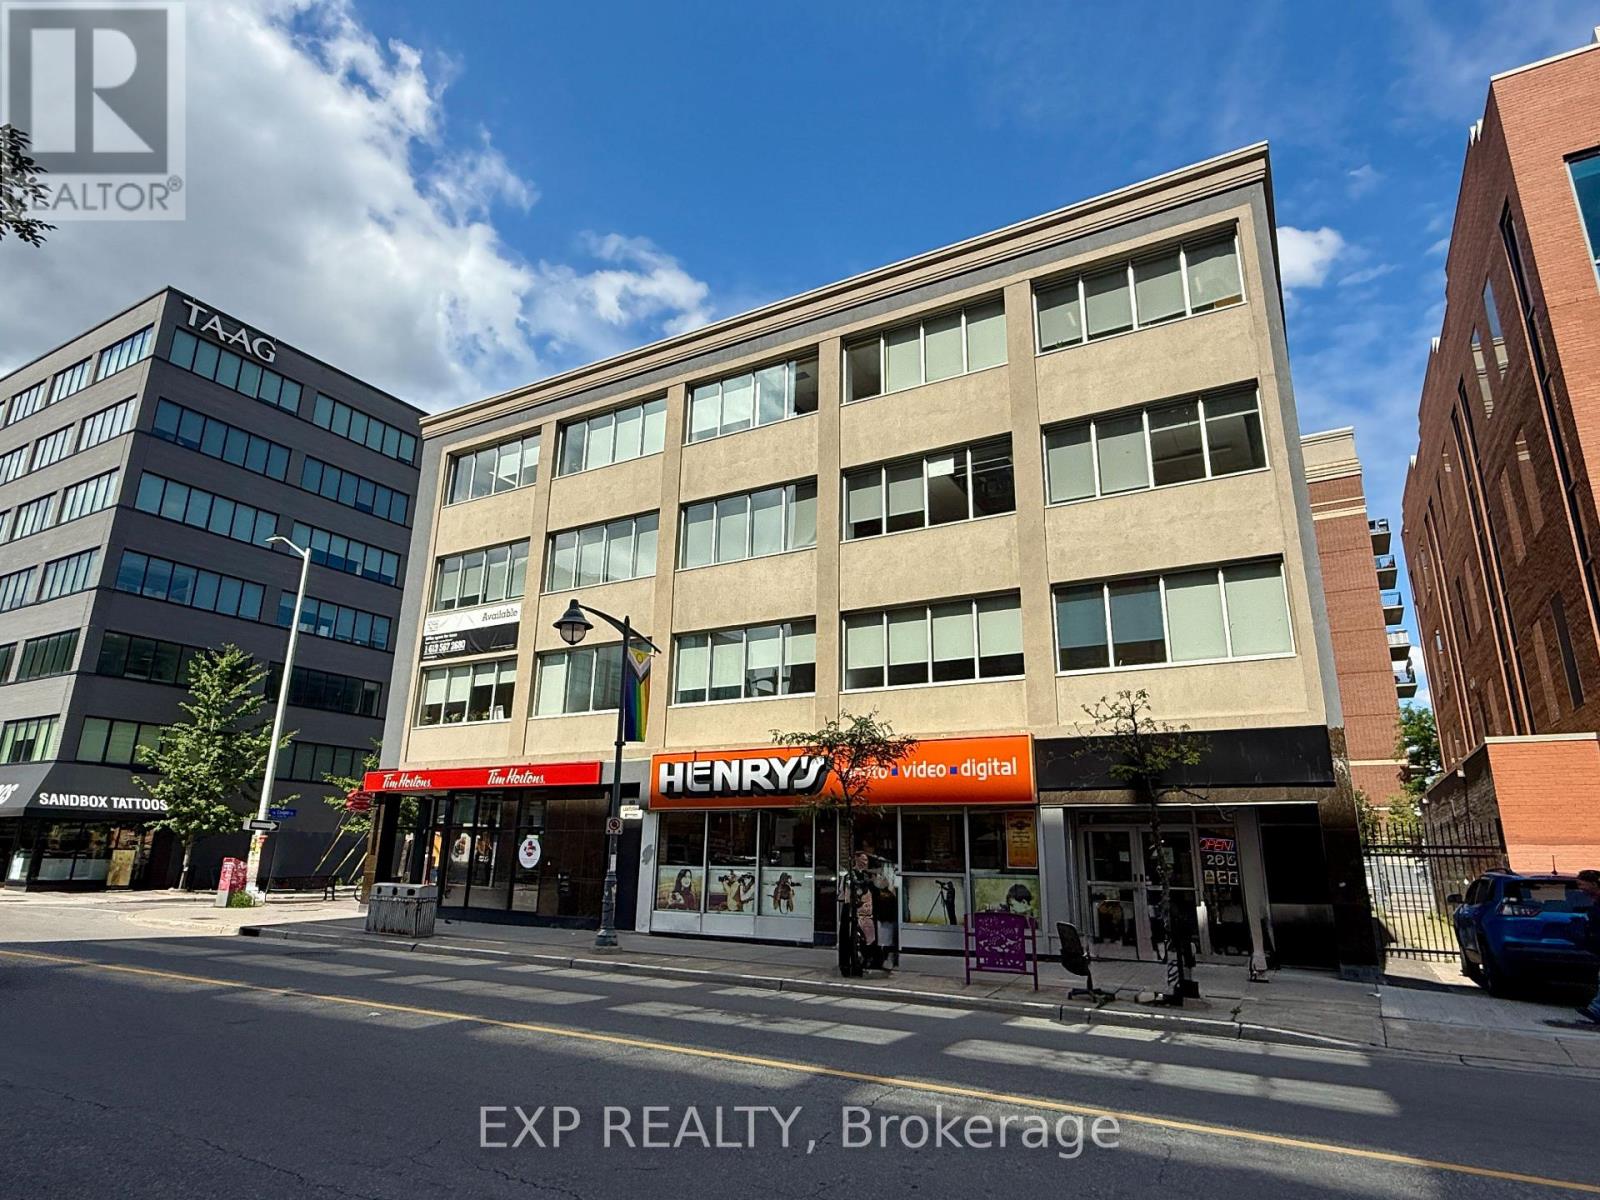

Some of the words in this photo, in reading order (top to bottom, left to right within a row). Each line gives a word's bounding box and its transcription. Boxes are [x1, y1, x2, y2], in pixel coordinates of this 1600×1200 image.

[183, 299, 278, 364] TAAG
[482, 608, 518, 621] Available
[487, 769, 505, 785] Tim
[505, 768, 544, 784] Hortons
[659, 755, 825, 793] HENRY'S
[902, 760, 947, 778] video
[960, 756, 1017, 780] digital
[382, 773, 398, 789] Tim
[398, 773, 432, 788] Hortons
[39, 792, 108, 809] SANDBOX
[111, 796, 169, 811] TATTOOS
